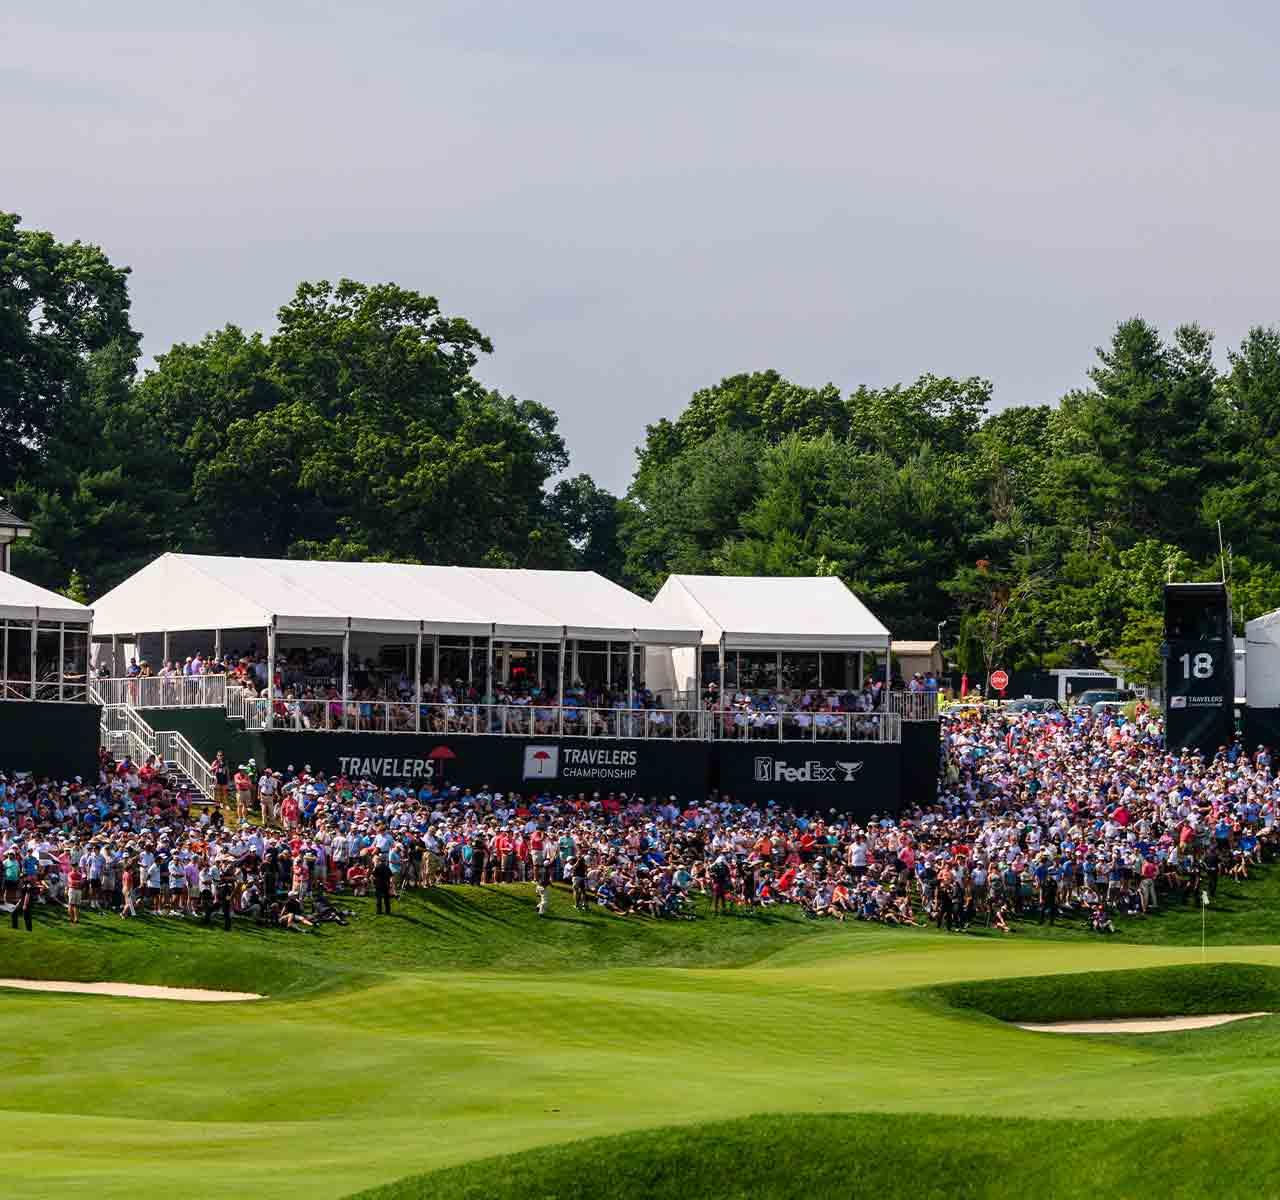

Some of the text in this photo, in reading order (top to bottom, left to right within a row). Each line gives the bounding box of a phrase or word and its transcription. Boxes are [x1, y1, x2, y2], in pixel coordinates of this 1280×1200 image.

[1180, 653, 1214, 679] 18
[338, 757, 435, 777] TRAVELERS
[563, 749, 637, 766] TRAVELERS
[563, 767, 637, 778] CHAMPIONSHIP
[774, 760, 836, 782] FedEx
